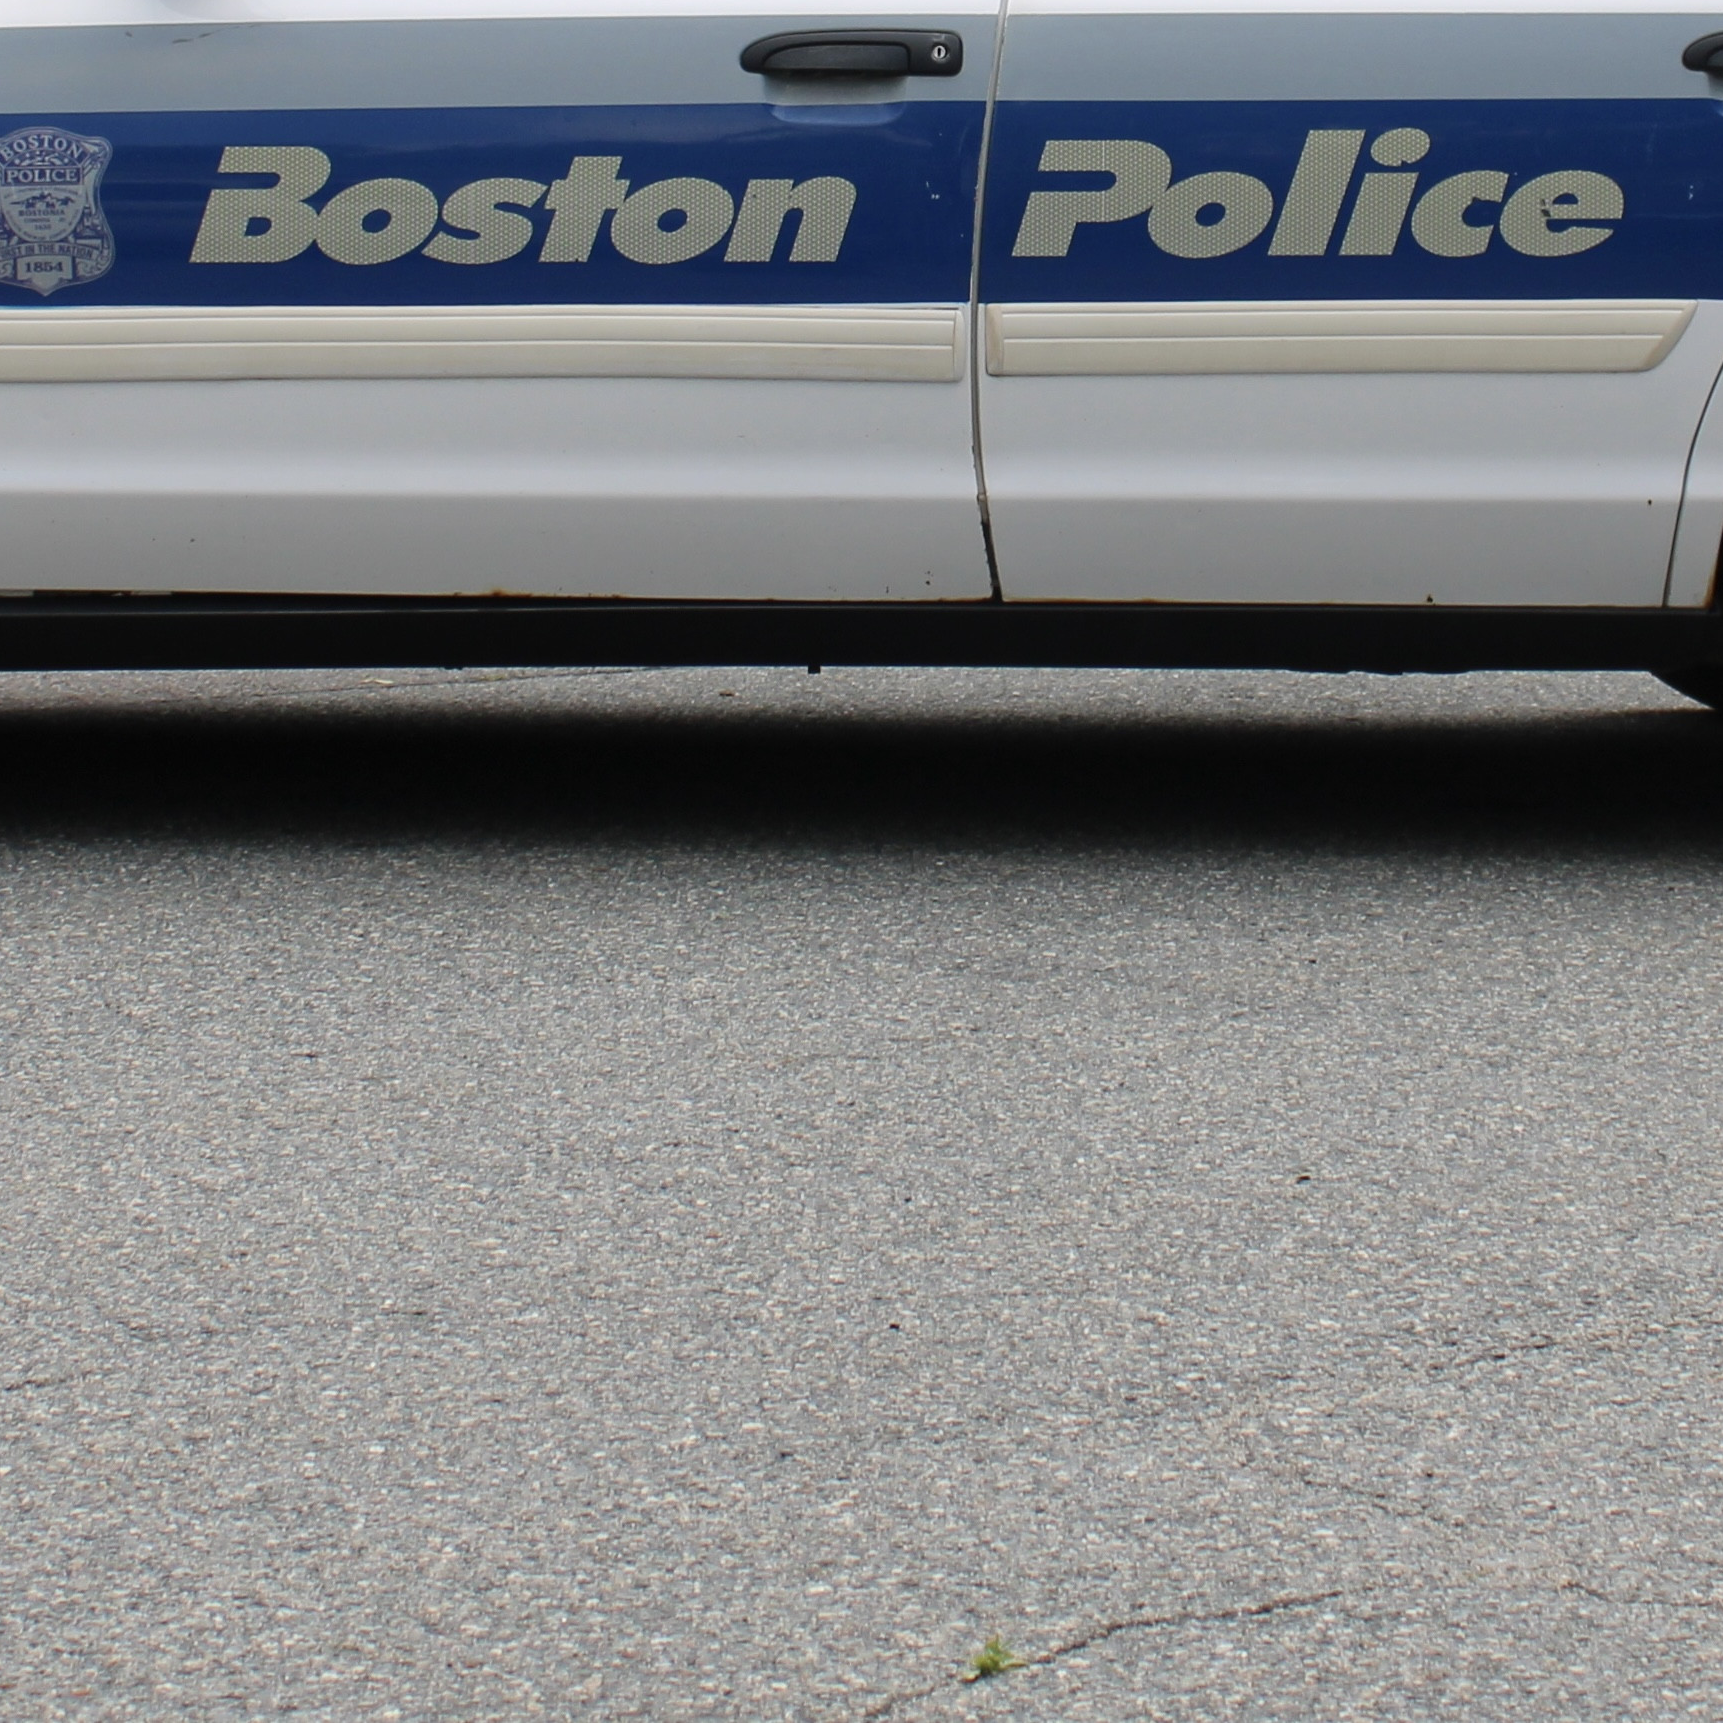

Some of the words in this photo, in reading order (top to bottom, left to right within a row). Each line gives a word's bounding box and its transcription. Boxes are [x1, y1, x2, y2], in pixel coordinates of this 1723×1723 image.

[0, 135, 83, 162] BOSTON
[6, 169, 77, 183] POLICE
[1011, 127, 1624, 258] Police
[189, 145, 857, 265] Boston
[39, 243, 55, 254] THE
[25, 261, 63, 273] 1854
